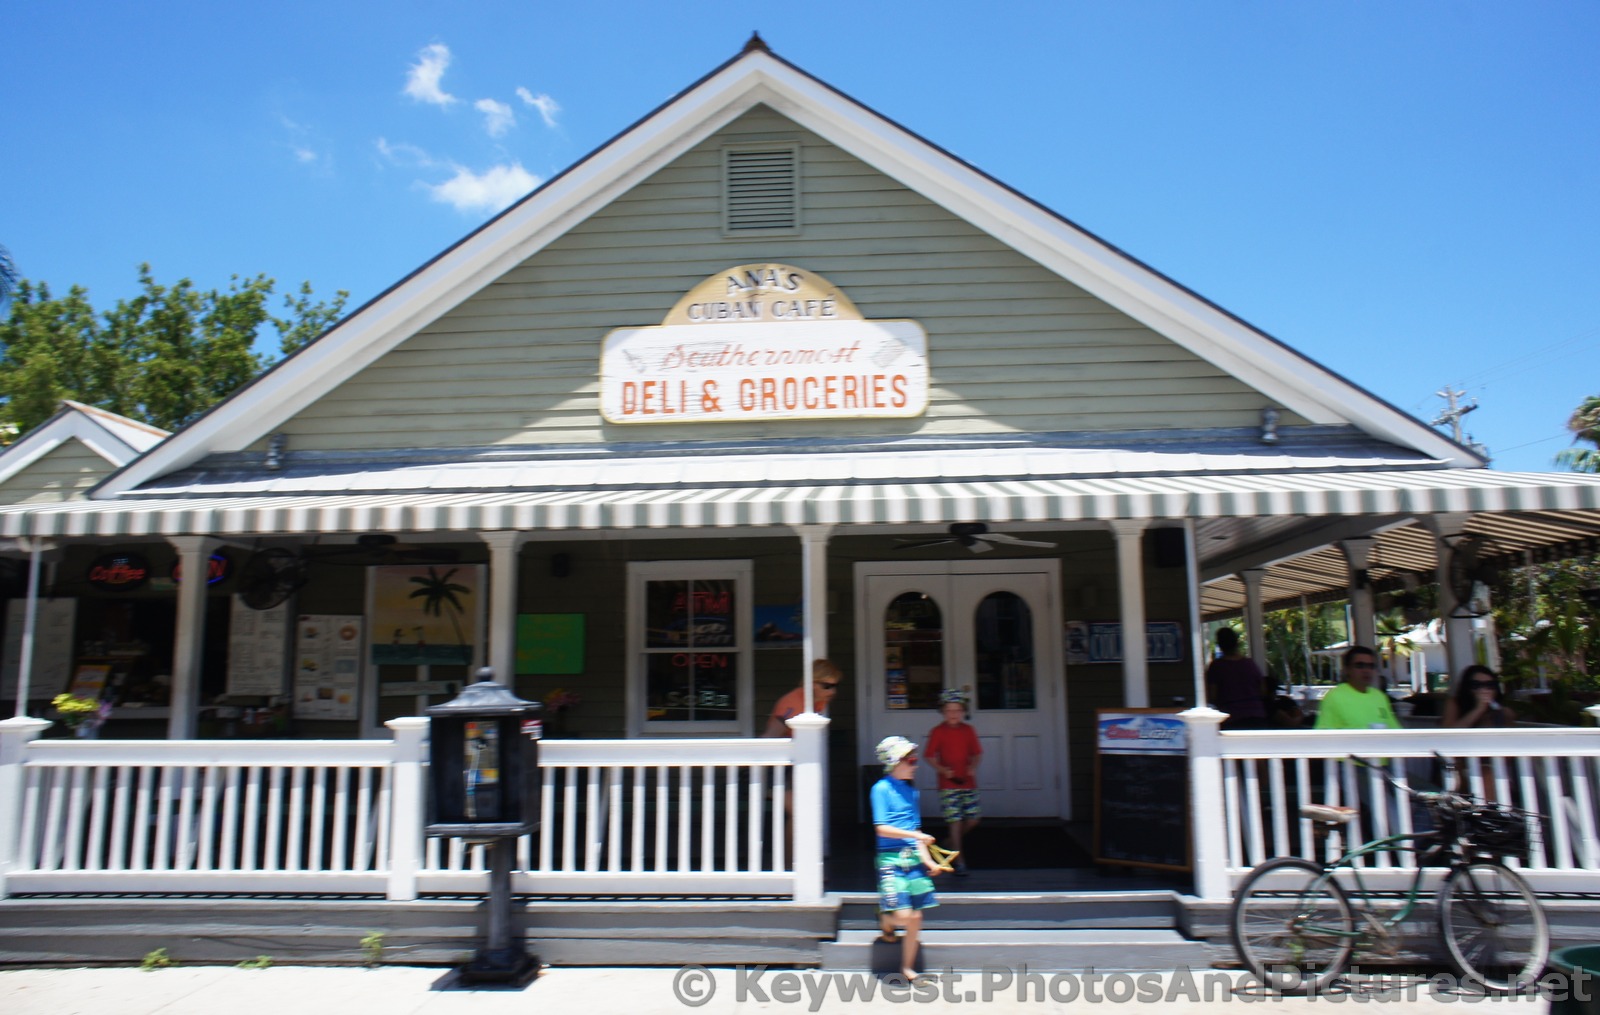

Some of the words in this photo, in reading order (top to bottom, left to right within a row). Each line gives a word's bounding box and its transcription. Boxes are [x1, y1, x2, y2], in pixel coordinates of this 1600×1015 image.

[727, 267, 804, 295] ANA'S
[688, 301, 761, 321] CUBAN
[622, 379, 686, 415] DELI
[702, 379, 723, 412] &
[739, 374, 908, 411] GROCERIES
[672, 591, 730, 613] ATM
